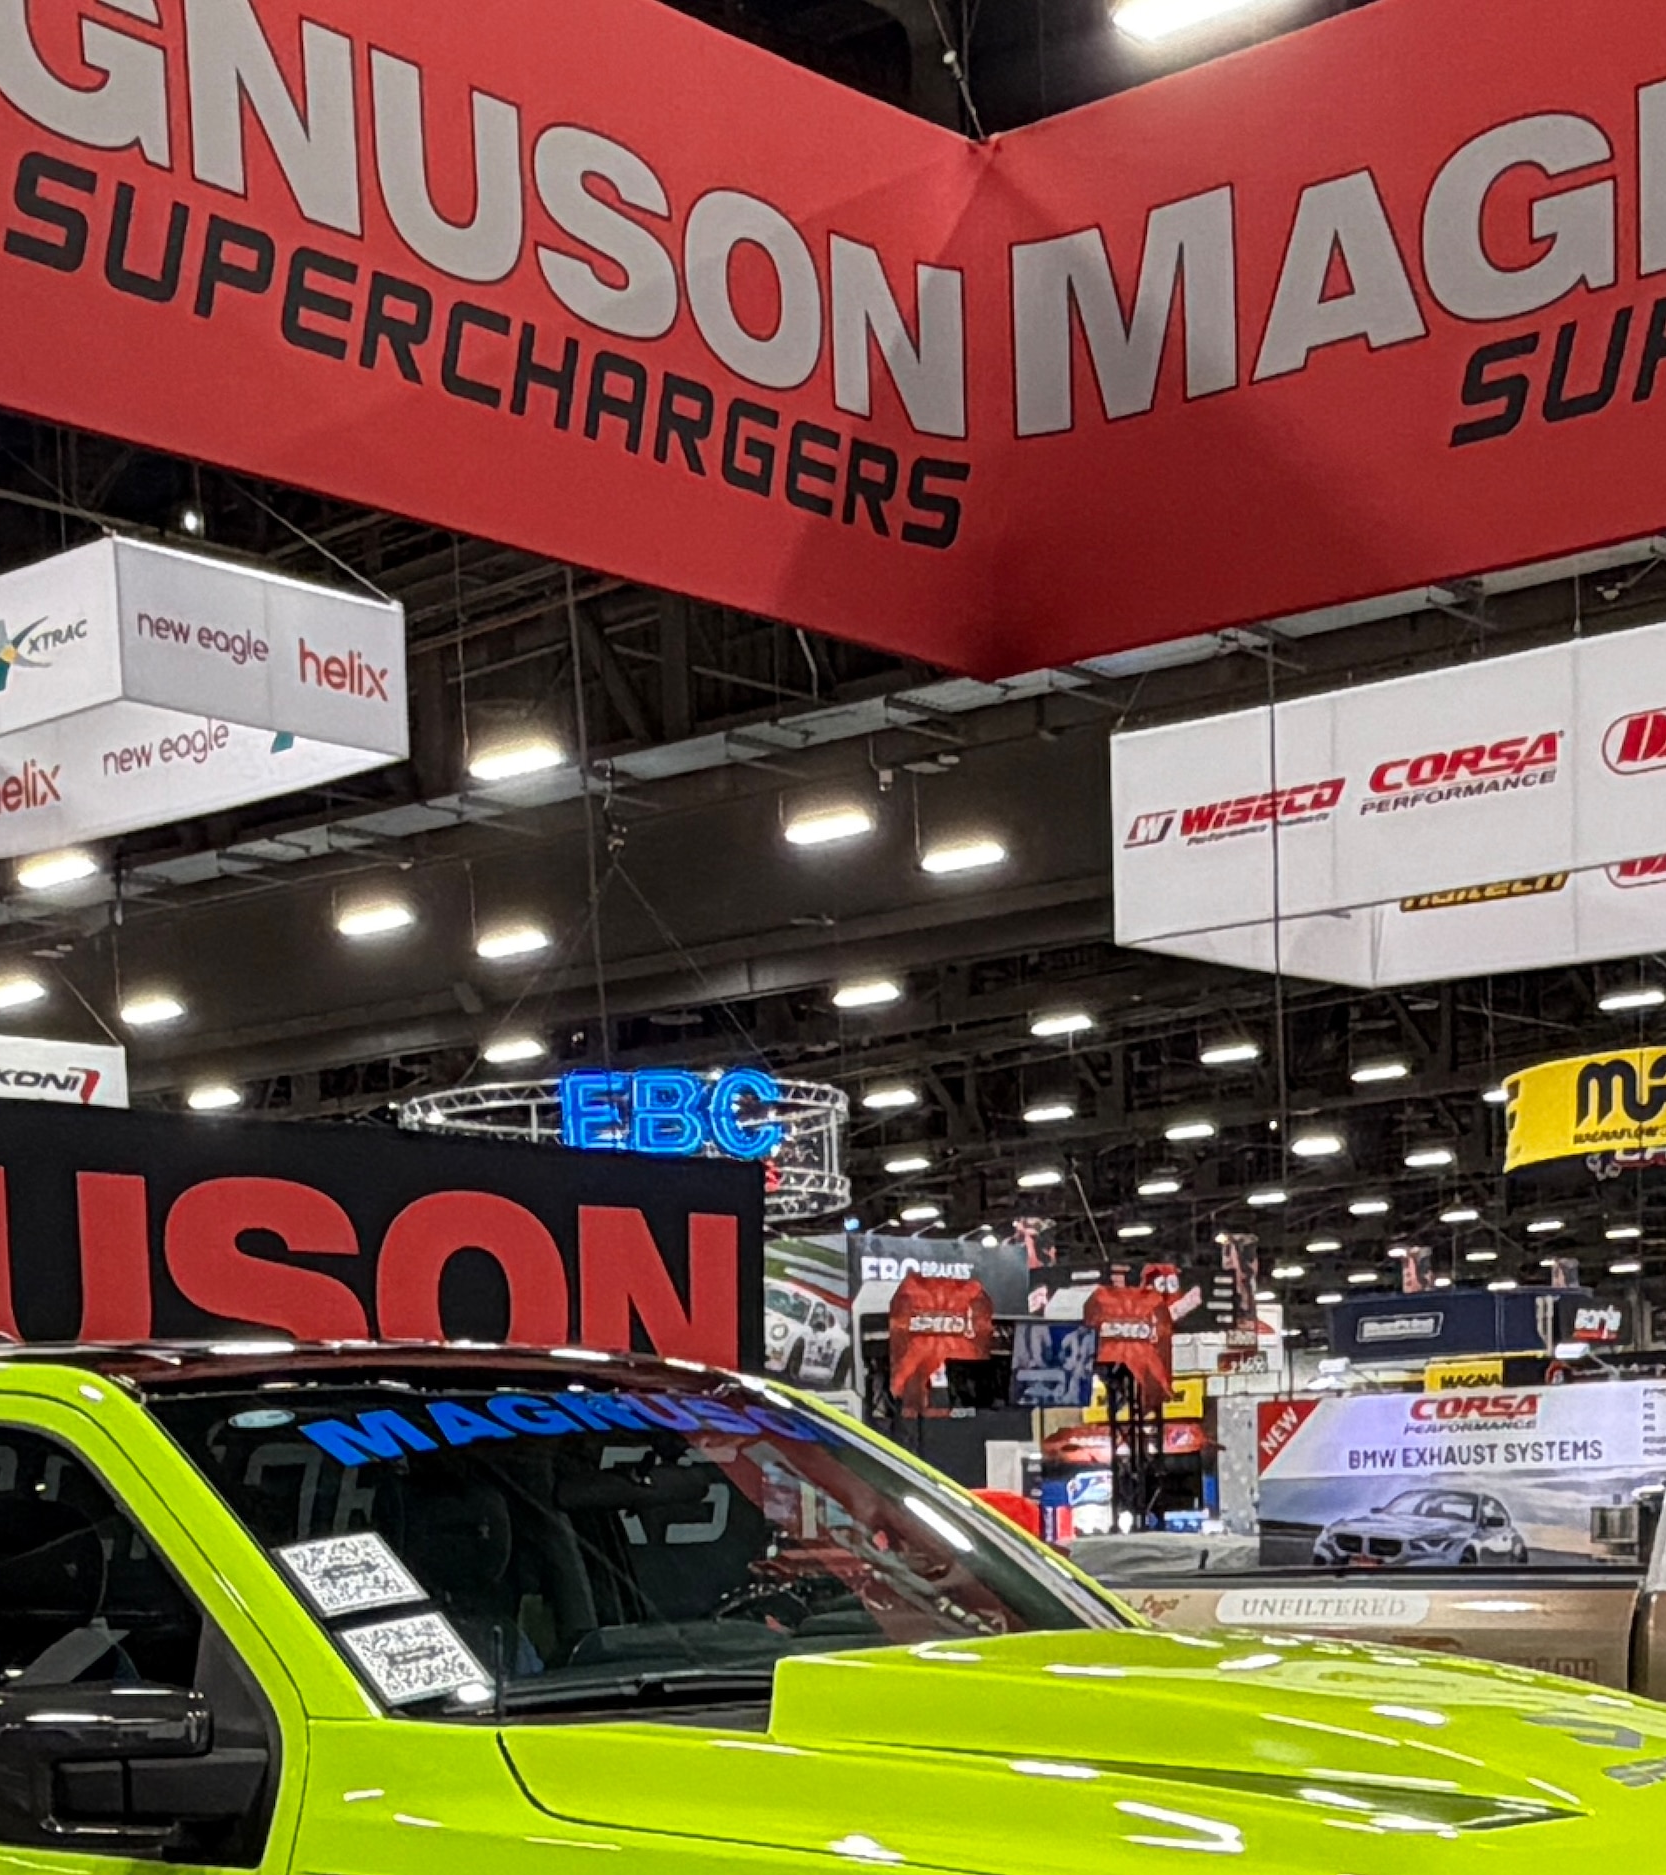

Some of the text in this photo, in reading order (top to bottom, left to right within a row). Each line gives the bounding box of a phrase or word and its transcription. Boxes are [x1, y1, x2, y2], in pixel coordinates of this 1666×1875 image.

[4, 151, 971, 550] SUPERCHARGERS
[26, 618, 89, 656] XTRAC
[137, 610, 269, 667] new eagle
[298, 637, 389, 702] helix
[103, 718, 229, 776] new eagle
[1368, 732, 1559, 794] CORSA
[1360, 770, 1556, 816] PERFORMANCE
[559, 1067, 784, 1161] EBC
[1259, 1407, 1299, 1457] NEW
[1403, 1420, 1537, 1436] PERFORMANCE
[1409, 1394, 1541, 1422] CORSA
[1348, 1439, 1603, 1470] BMW EXHAUST SYSTEMS
[1241, 1595, 1407, 1619] UNFILTERED
